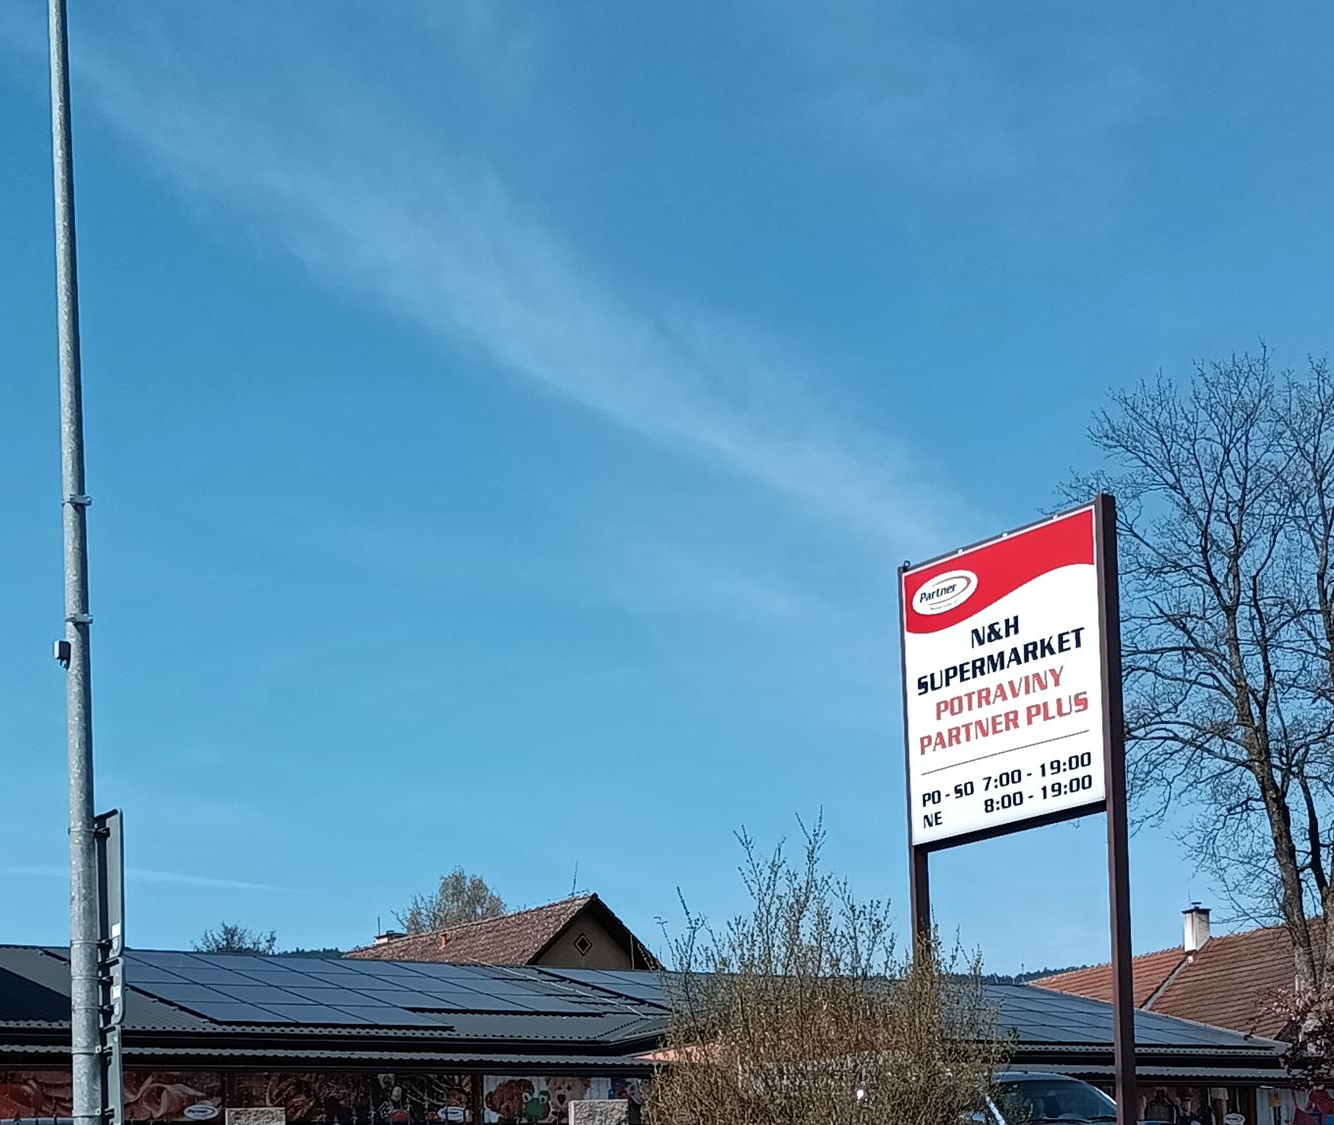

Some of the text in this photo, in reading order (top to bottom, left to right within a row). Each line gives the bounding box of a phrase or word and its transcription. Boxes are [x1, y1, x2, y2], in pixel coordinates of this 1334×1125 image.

[919, 583, 957, 603] Partner
[970, 615, 1020, 649] N&H
[917, 627, 1085, 696] SUPERMARKET
[935, 665, 1064, 721] POTRAVINY
[919, 691, 1089, 756] PARTNER PLUS
[922, 789, 942, 807] PO
[954, 781, 975, 800] SO
[982, 769, 1022, 793] 7:00
[1040, 752, 1092, 777] 19:00
[922, 811, 944, 829] NE
[984, 792, 1024, 814] 8:00
[1041, 774, 1093, 801] 19:00
